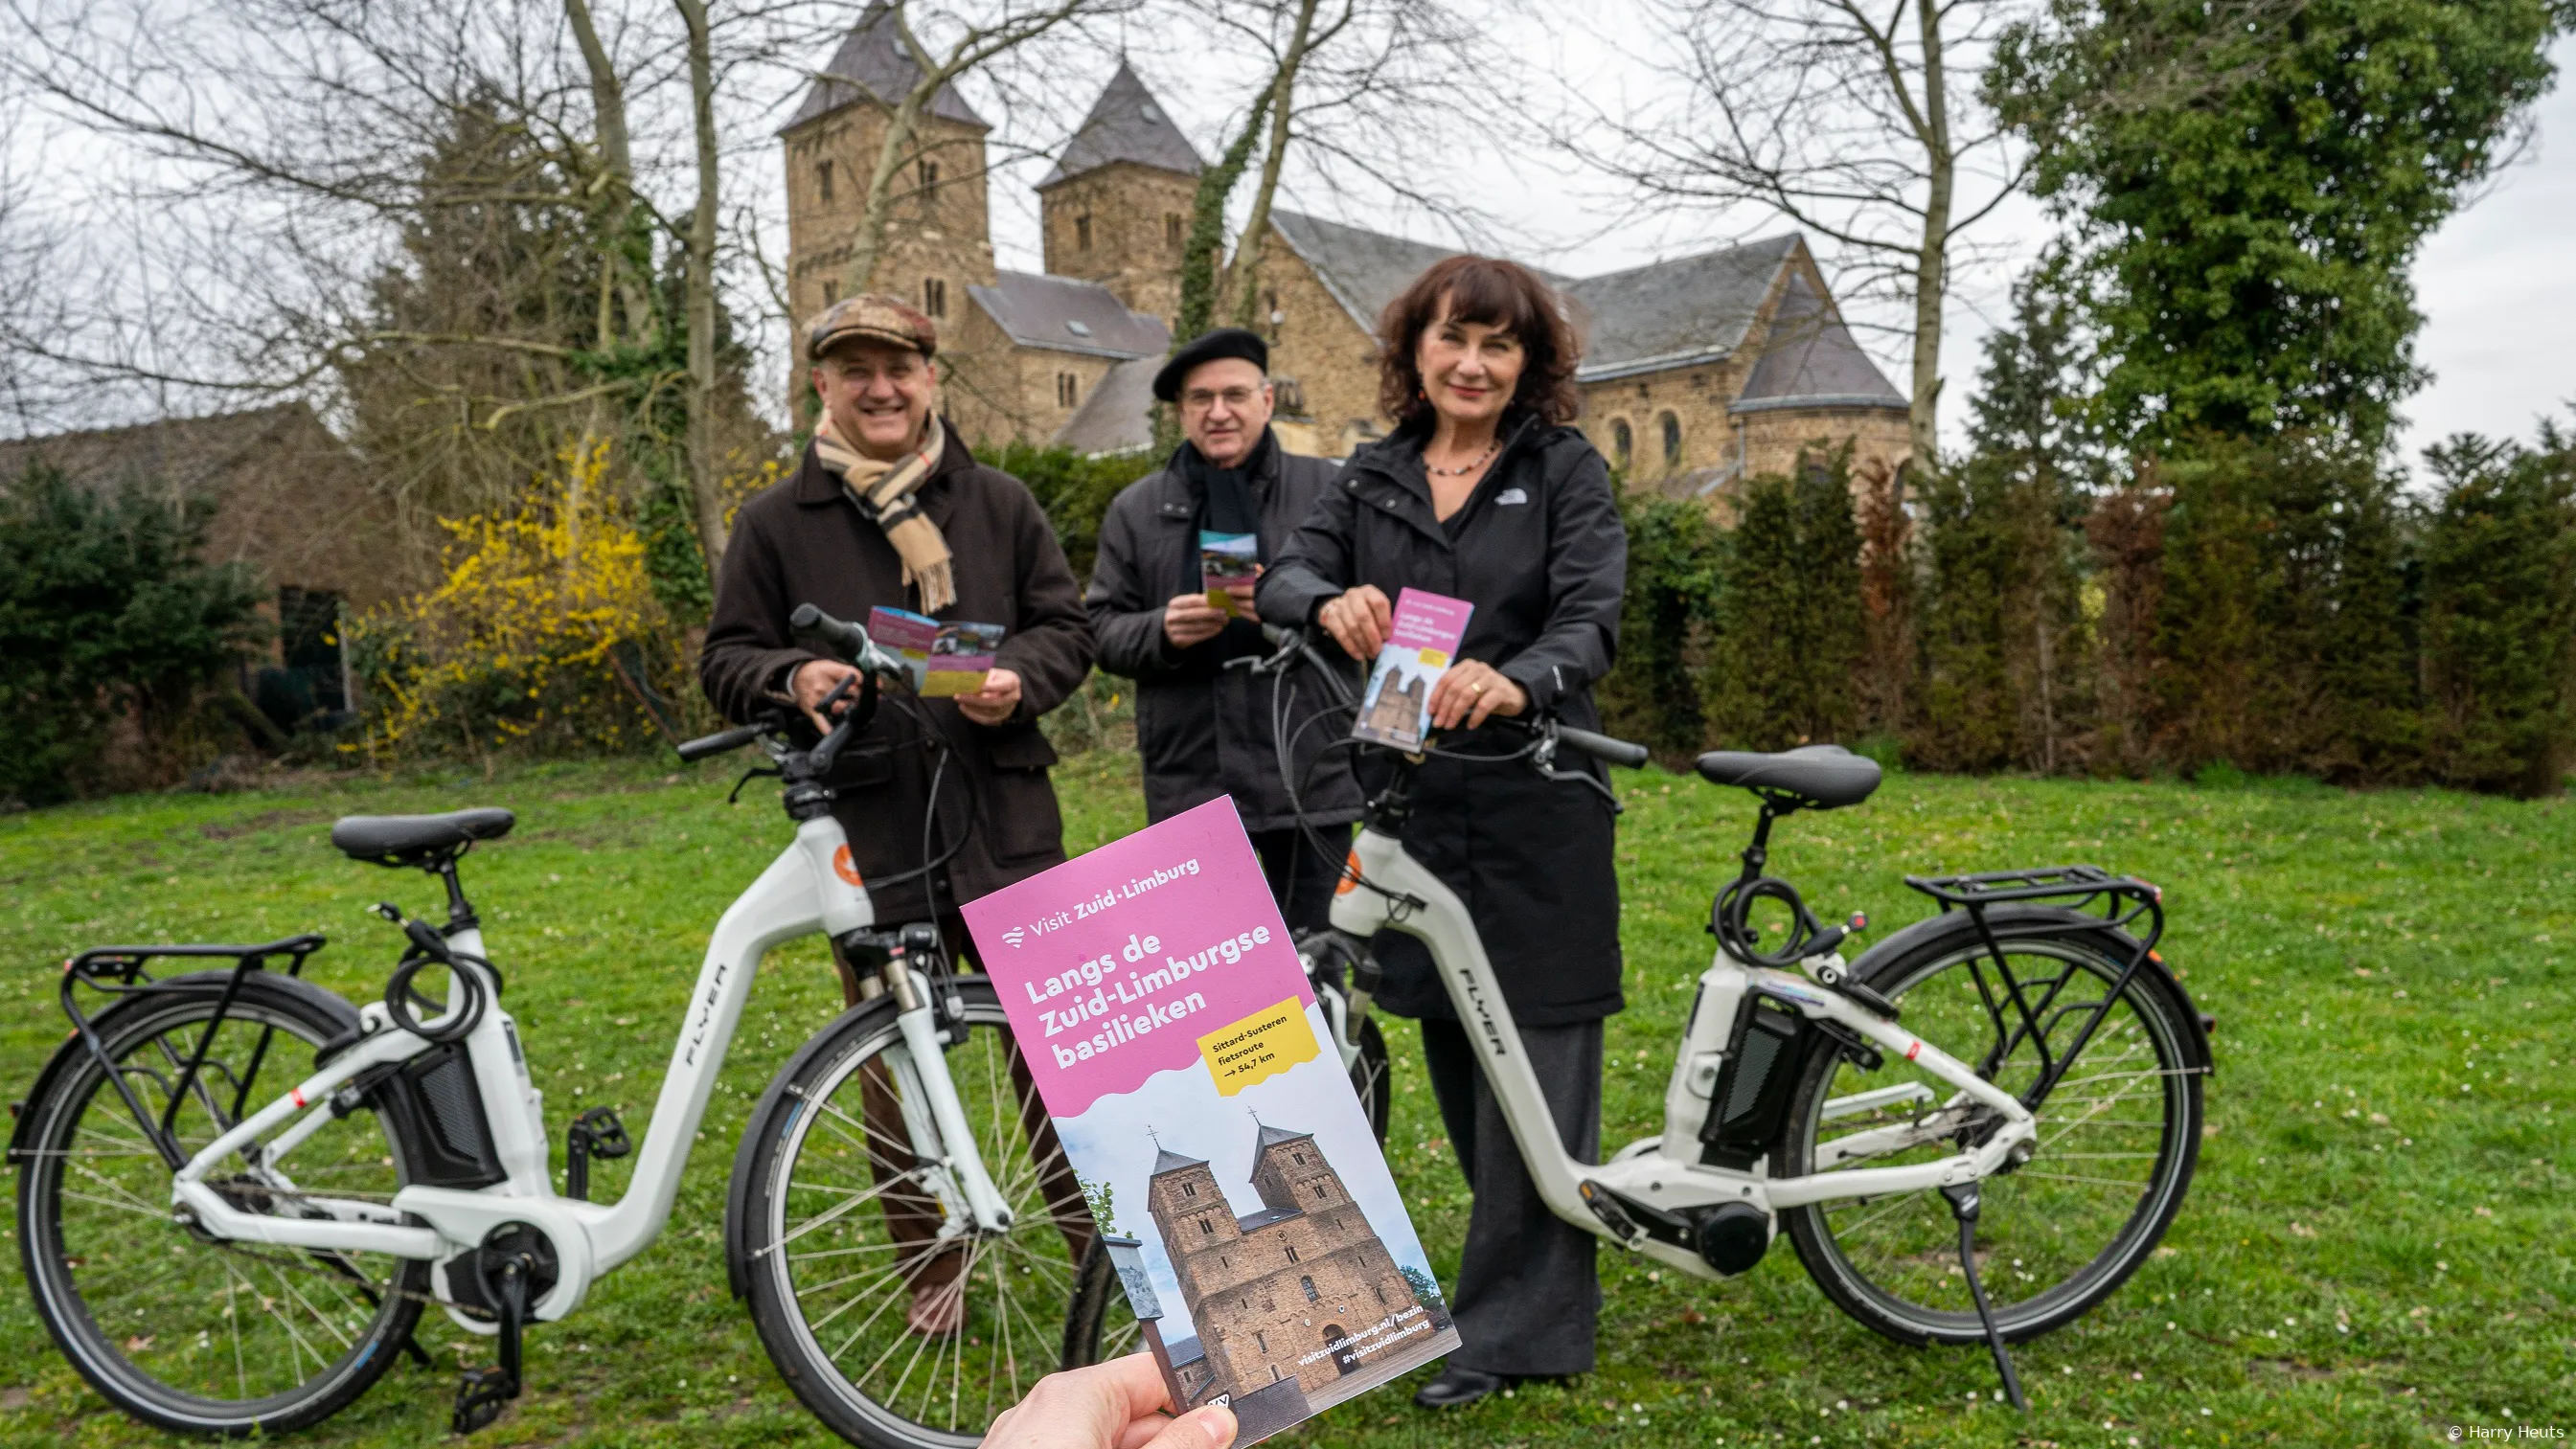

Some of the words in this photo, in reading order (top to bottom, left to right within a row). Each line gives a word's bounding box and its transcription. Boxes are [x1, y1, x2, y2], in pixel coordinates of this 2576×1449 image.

[1029, 911, 1073, 938] Visit
[1025, 954, 1117, 1005] Langs
[1123, 933, 1162, 965] de
[1037, 925, 1271, 1038] Zuid-Limburgse
[686, 964, 727, 1068] FLYER
[1051, 990, 1207, 1070] basilieken
[1212, 1014, 1288, 1053] Sittard-Susteren
[1459, 967, 1507, 1055] FLYER
[1218, 1039, 1265, 1067] fietsroute
[1238, 1057, 1257, 1075] 54,7
[1258, 1053, 1276, 1065] km
[1297, 1303, 1425, 1367] visitzuidlimburg.nl/bezin
[1342, 1318, 1430, 1365] #visitzuidlimburg
